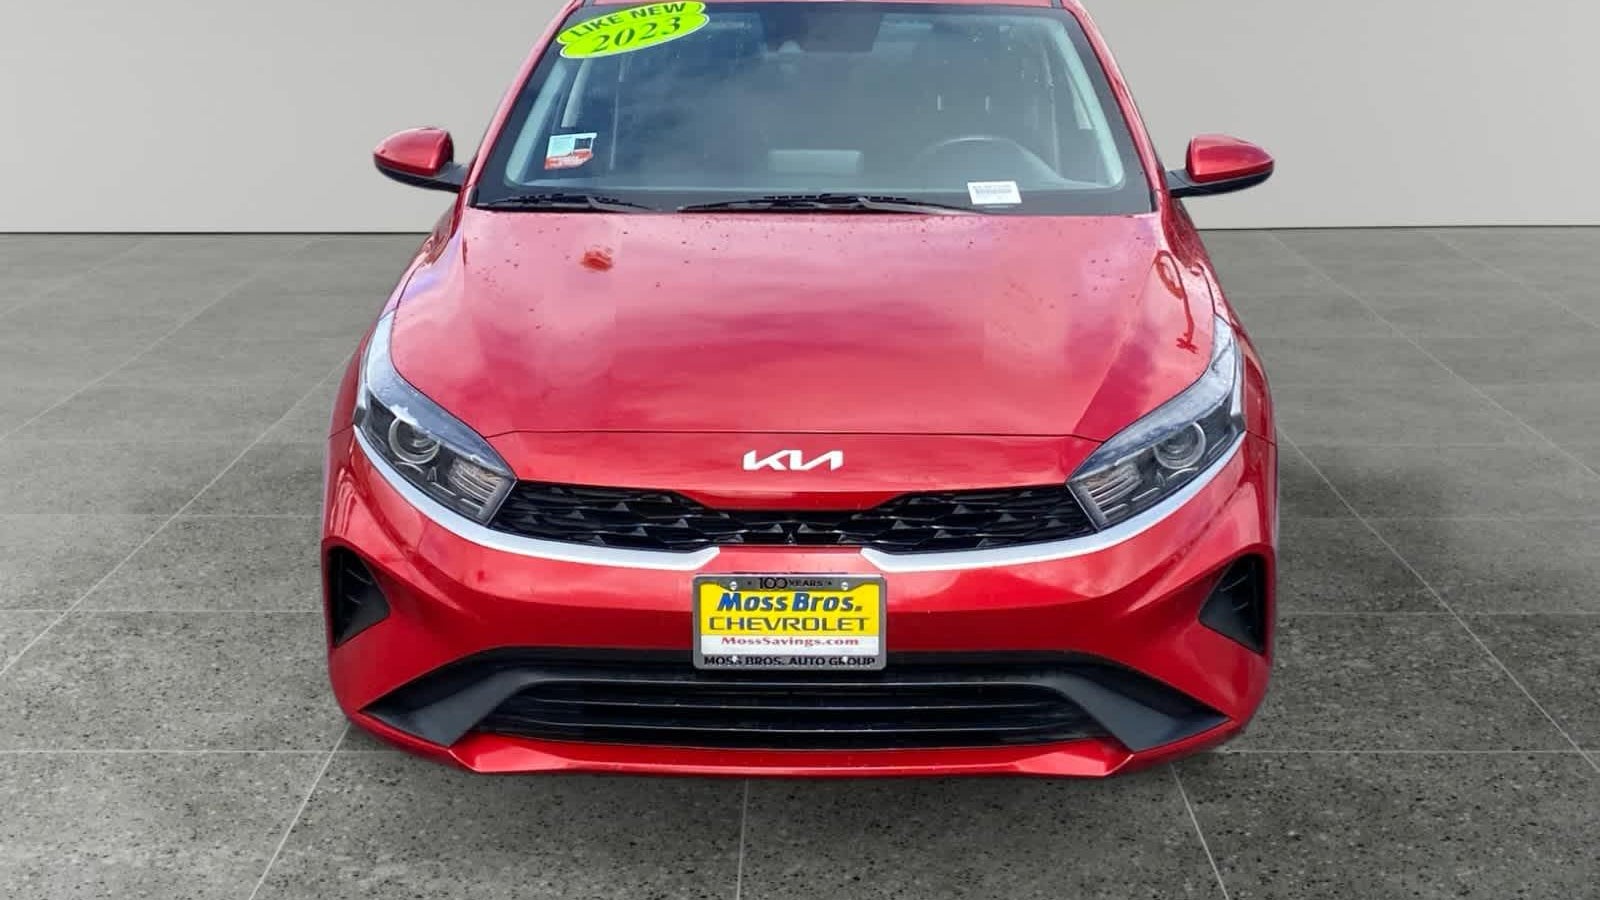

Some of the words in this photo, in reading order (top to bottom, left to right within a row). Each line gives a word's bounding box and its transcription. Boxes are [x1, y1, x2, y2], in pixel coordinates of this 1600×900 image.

[570, 15, 624, 37] LIKE
[631, 3, 686, 19] NEW
[592, 17, 681, 53] 2023
[743, 449, 843, 471] KIA
[717, 592, 787, 612] Moss
[792, 592, 862, 612] Bros.
[709, 617, 869, 631] CHEVROLET
[721, 637, 859, 646] MossSavings.com
[745, 656, 785, 666] BROS.
[788, 656, 826, 666] AUTO
